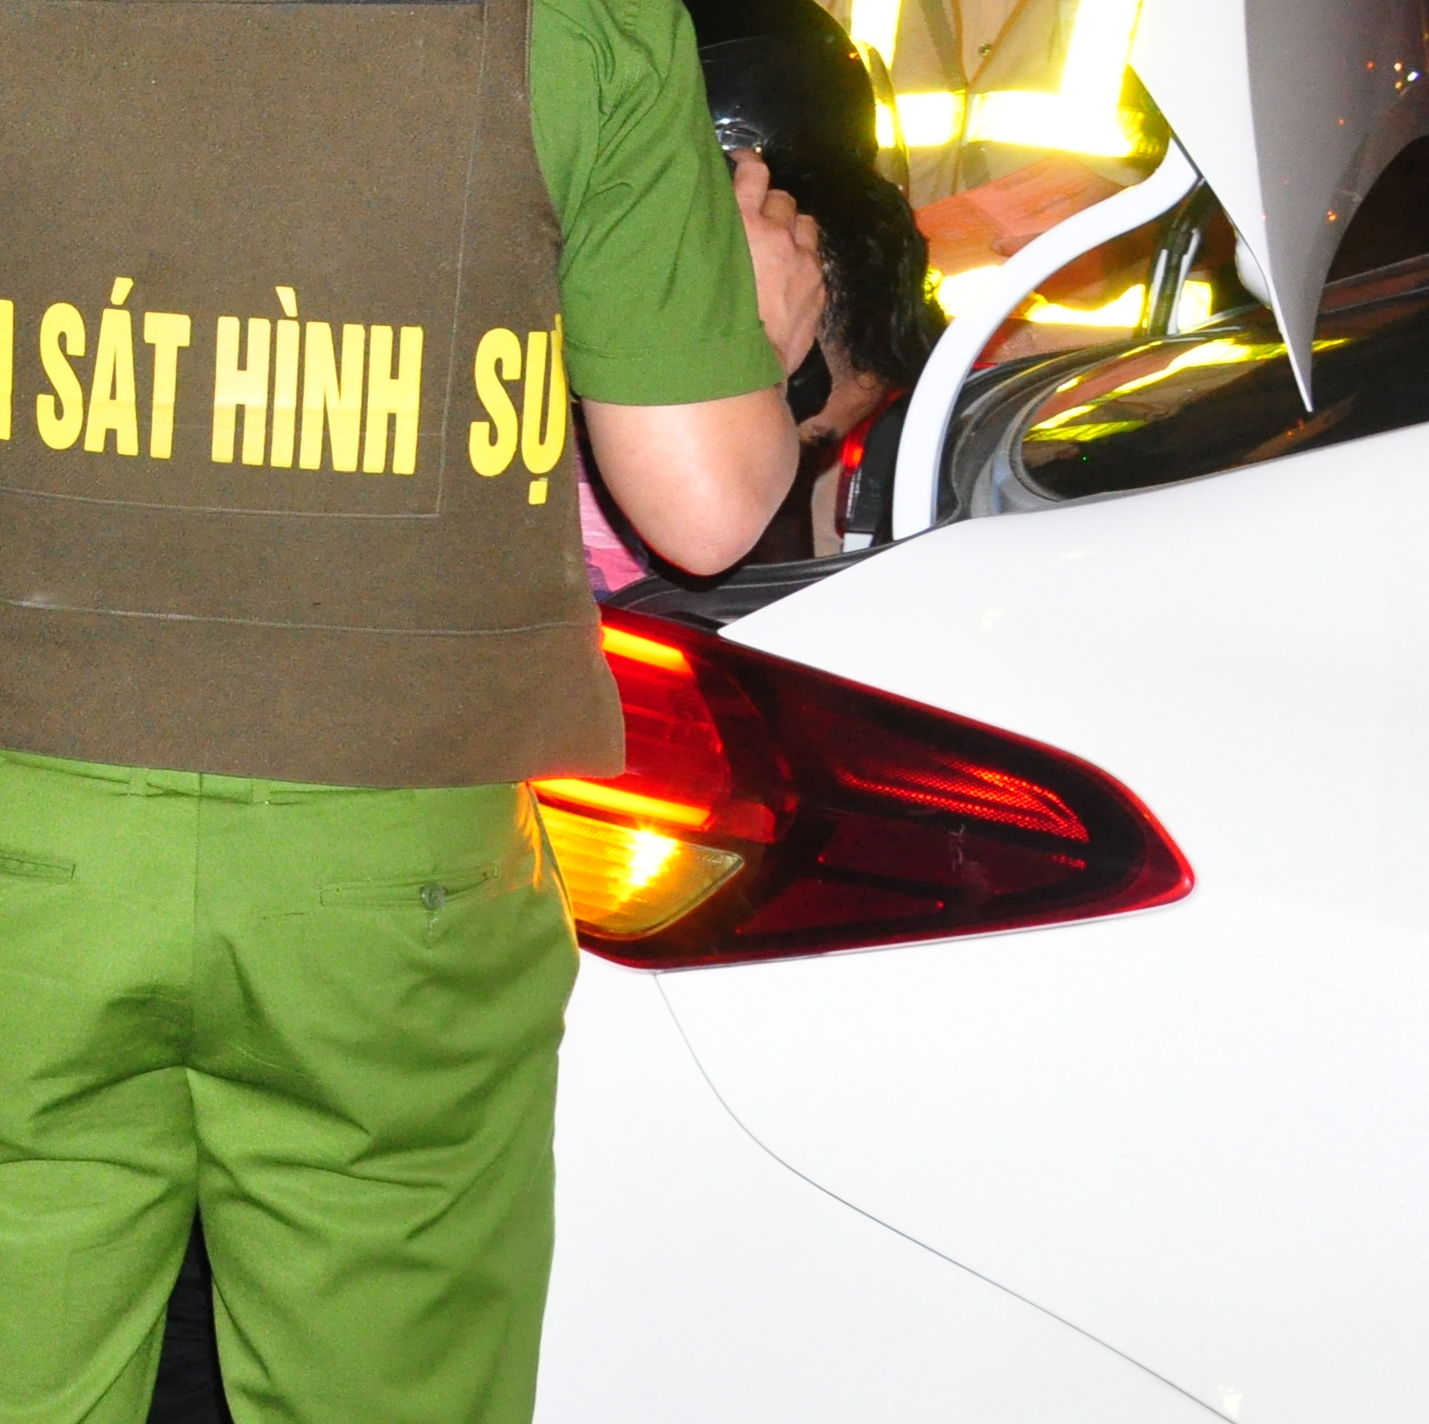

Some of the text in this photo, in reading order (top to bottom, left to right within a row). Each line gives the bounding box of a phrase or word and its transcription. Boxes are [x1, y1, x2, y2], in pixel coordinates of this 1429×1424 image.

[36, 277, 191, 459] SÁT
[212, 286, 423, 474] HÌNH
[469, 313, 567, 505] SỰ
